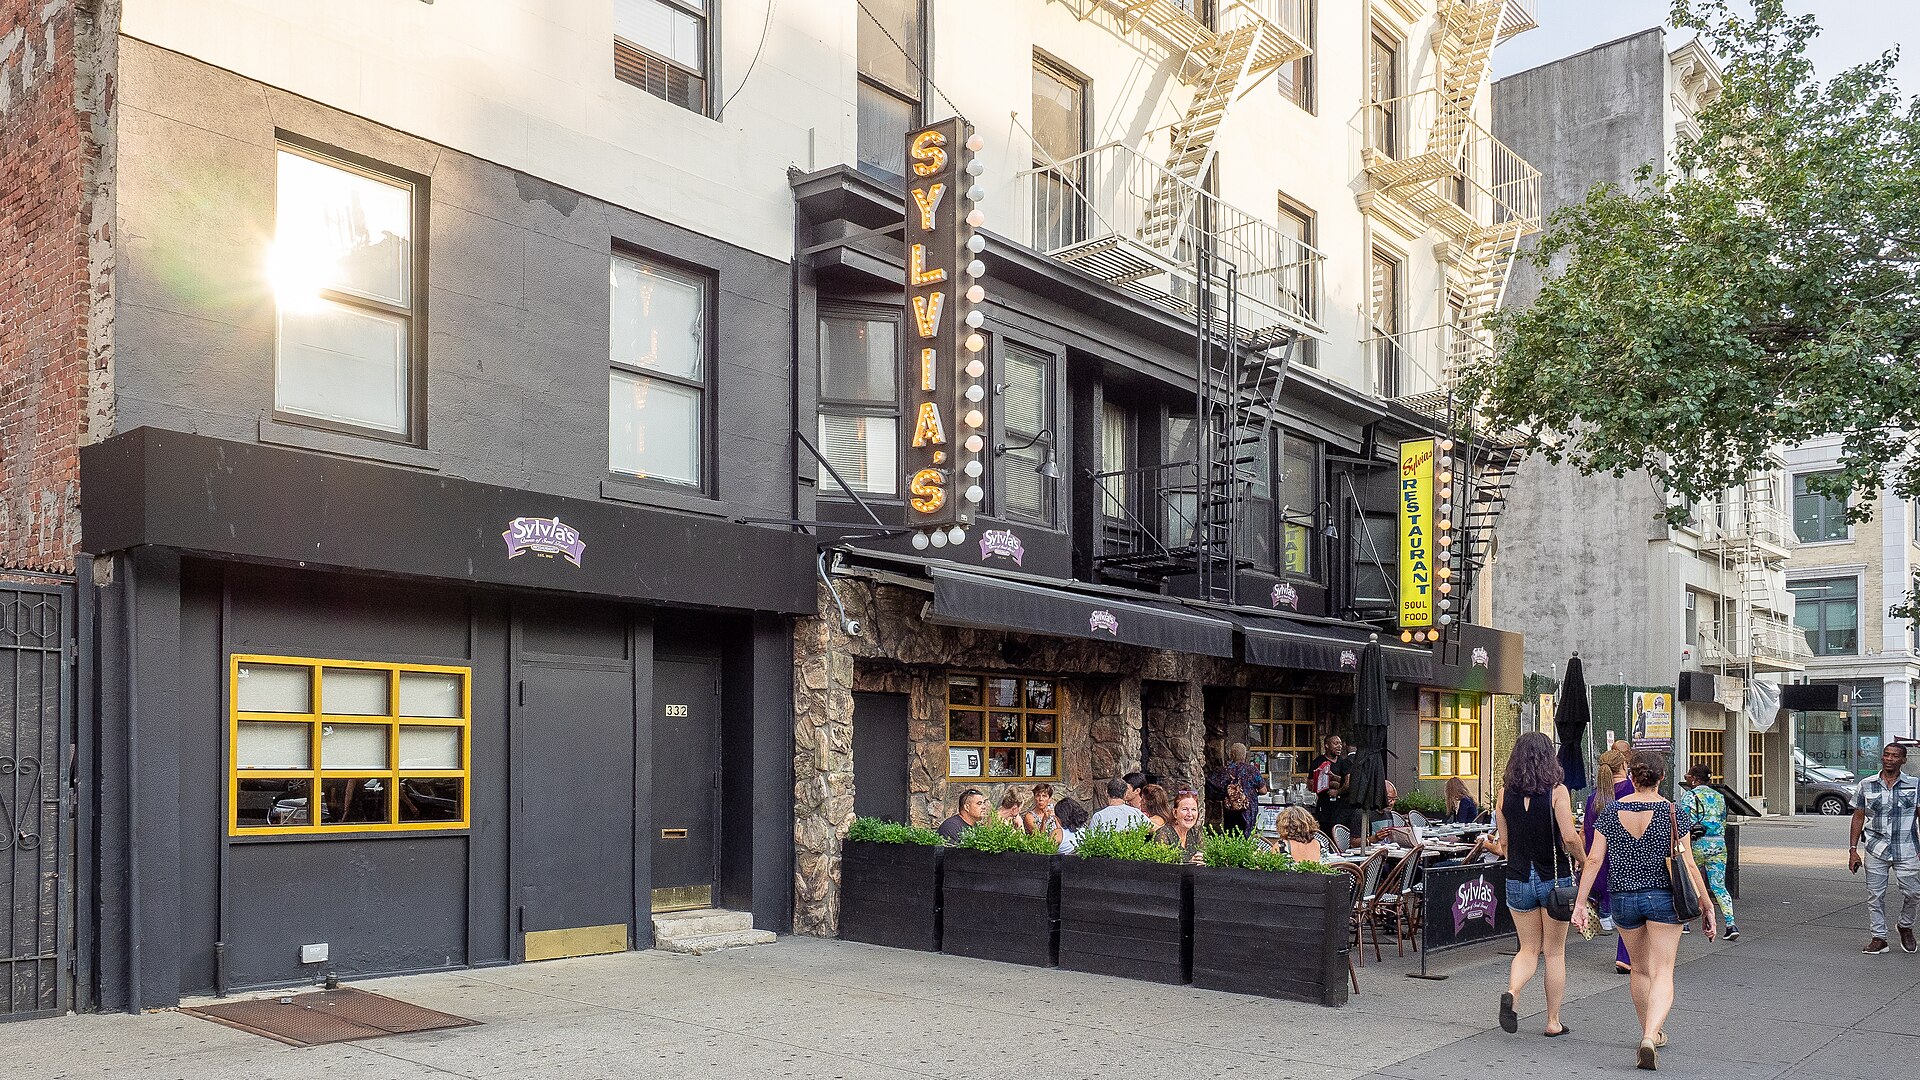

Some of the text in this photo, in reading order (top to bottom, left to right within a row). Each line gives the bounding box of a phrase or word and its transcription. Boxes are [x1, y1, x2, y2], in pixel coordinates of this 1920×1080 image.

[911, 130, 948, 514] SYLVIA'S
[513, 516, 575, 545] Sylvia's
[985, 529, 1019, 550] Sylvia's
[1403, 479, 1430, 594] RESTAURANT
[1404, 601, 1427, 610] SOUL
[1404, 612, 1428, 621] FOOD
[667, 705, 687, 716] 332
[1458, 874, 1492, 909] Sylvia's
